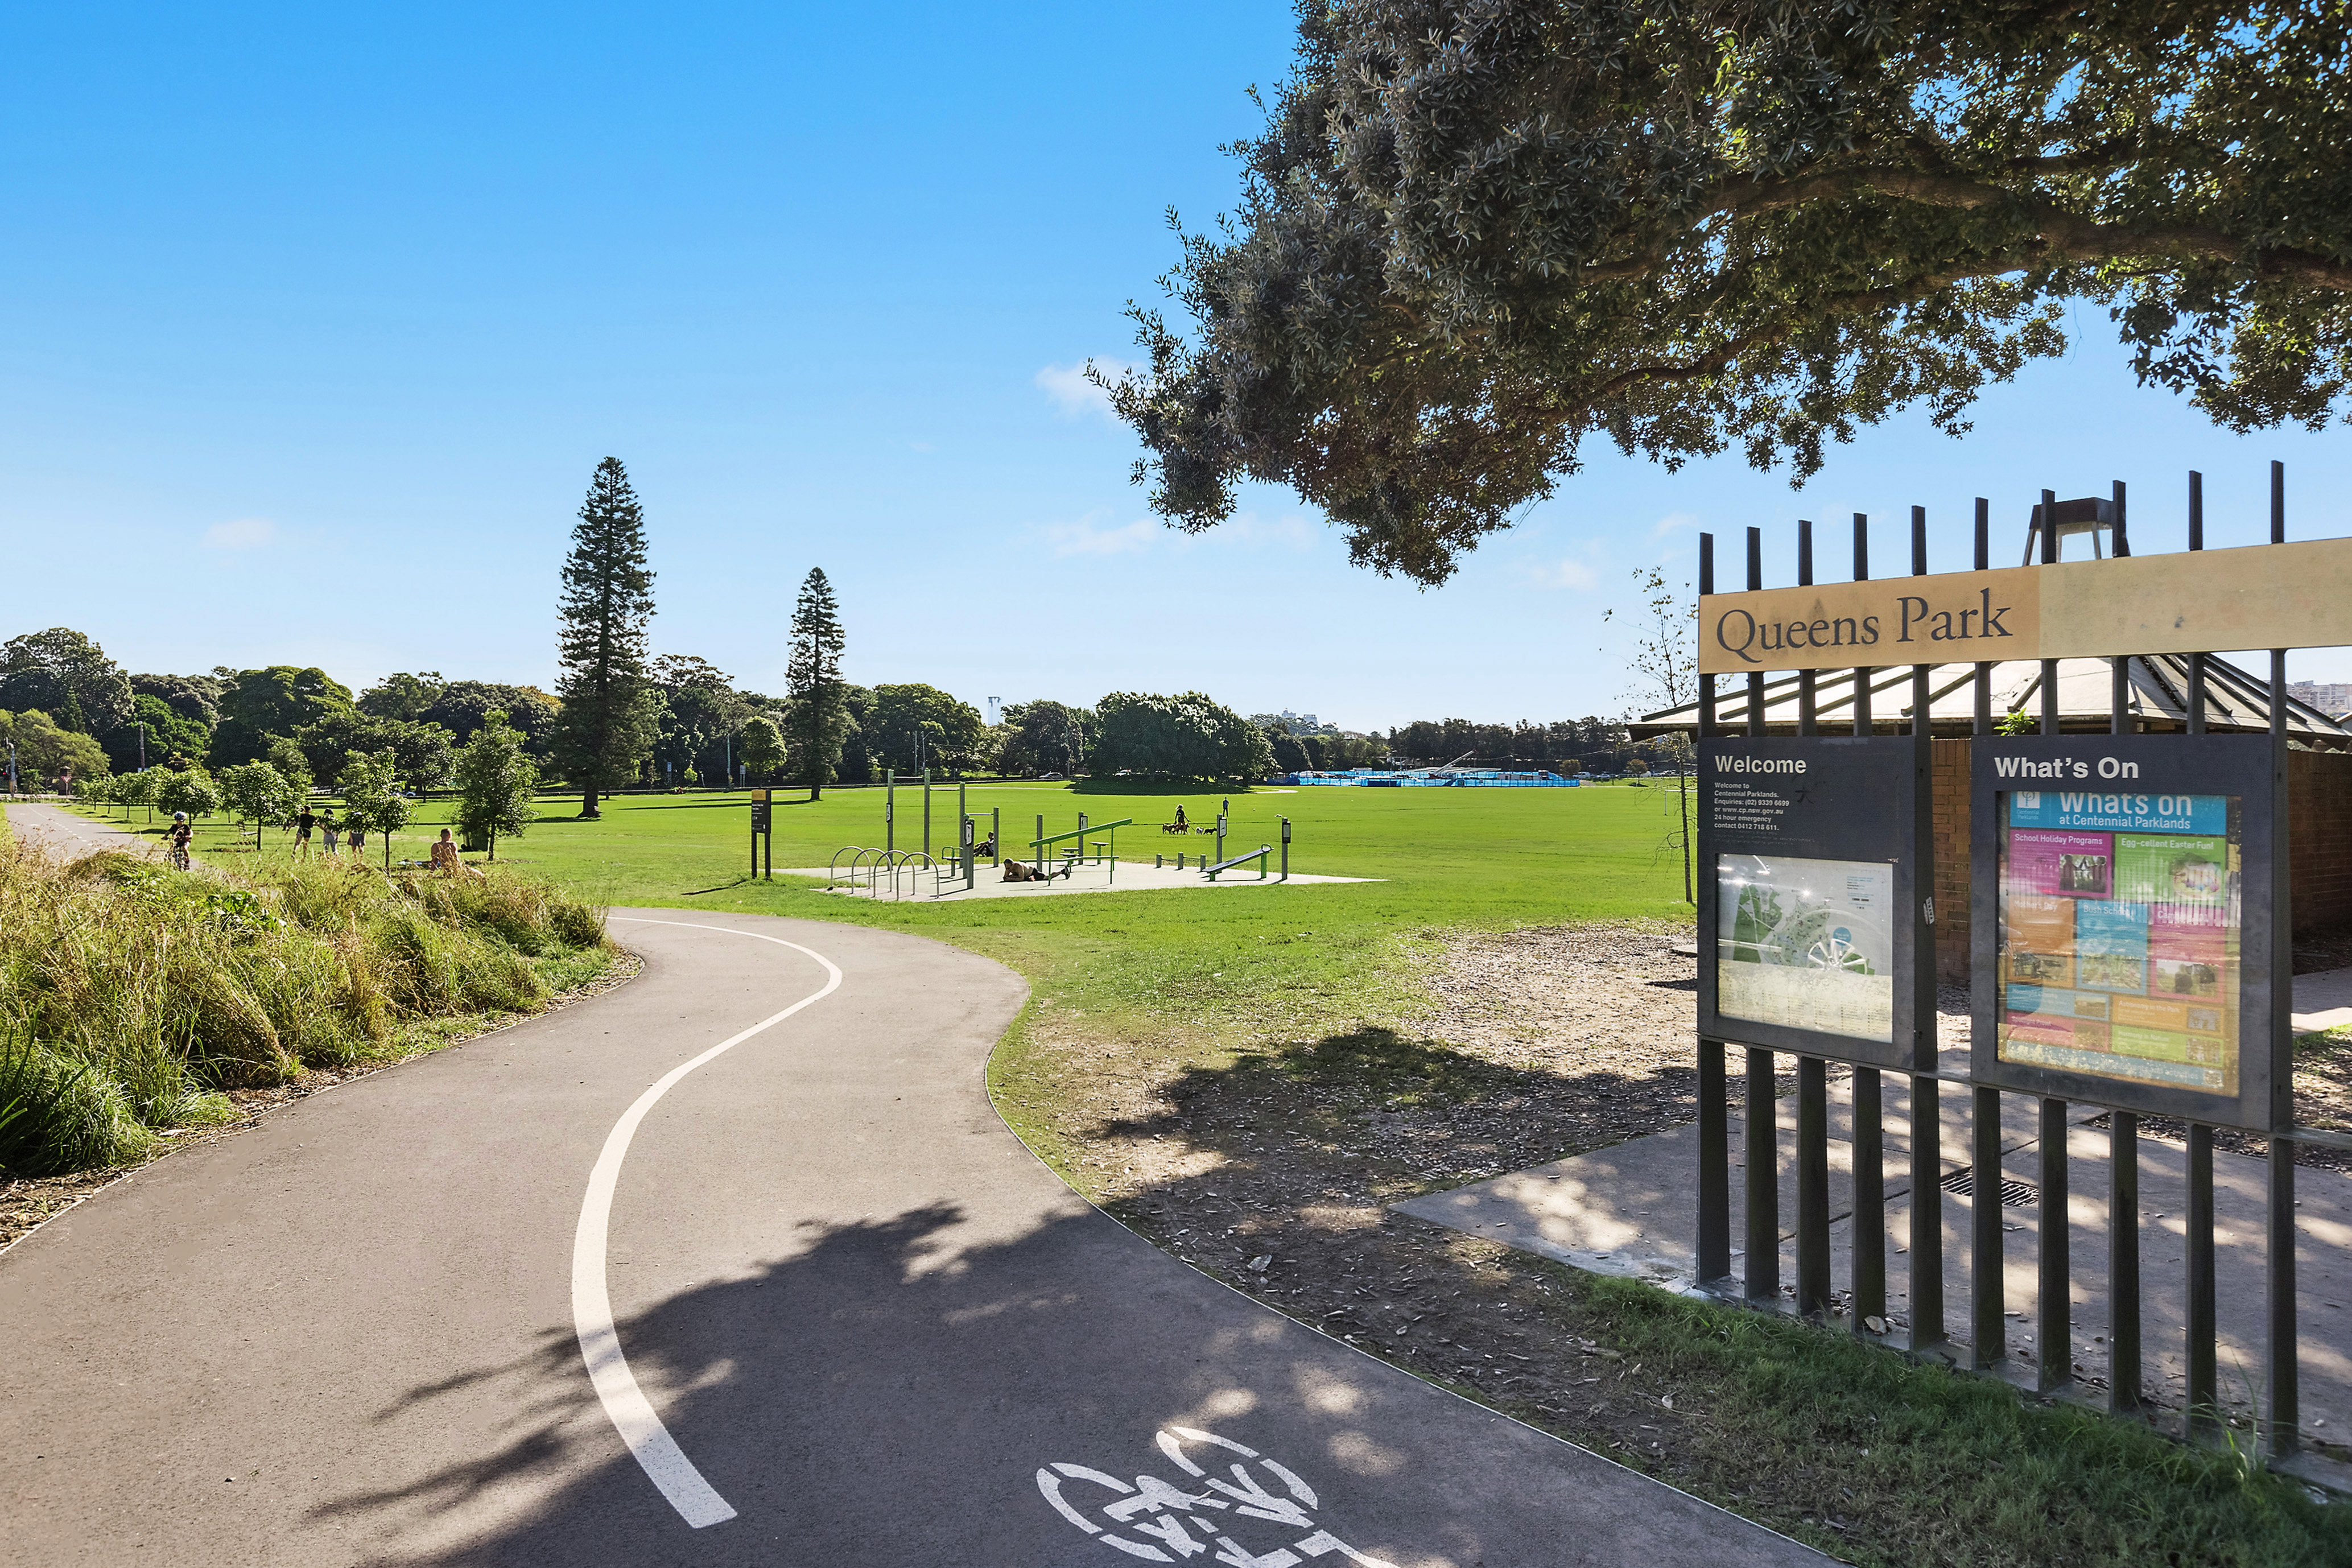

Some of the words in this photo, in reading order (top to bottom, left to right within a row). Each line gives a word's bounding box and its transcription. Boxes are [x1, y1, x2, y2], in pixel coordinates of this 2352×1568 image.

[1716, 608, 1879, 663] Queens
[1896, 587, 2013, 643] Park
[1714, 755, 1807, 774] Welcome
[1994, 757, 2089, 778] What's
[2098, 757, 2139, 778] On
[2059, 792, 2148, 815] Whats
[2158, 795, 2192, 816] on
[2059, 814, 2070, 824] at
[2073, 814, 2133, 827] Centennial
[2135, 816, 2190, 830] Parklands
[2015, 833, 2039, 843] School
[2040, 835, 2067, 845] Holiday
[2068, 836, 2103, 846] Programs
[2121, 838, 2168, 848] Egg-cellent
[2169, 840, 2195, 849] Easter
[2197, 841, 2214, 850] Fun!
[2083, 904, 2102, 914] Bush
